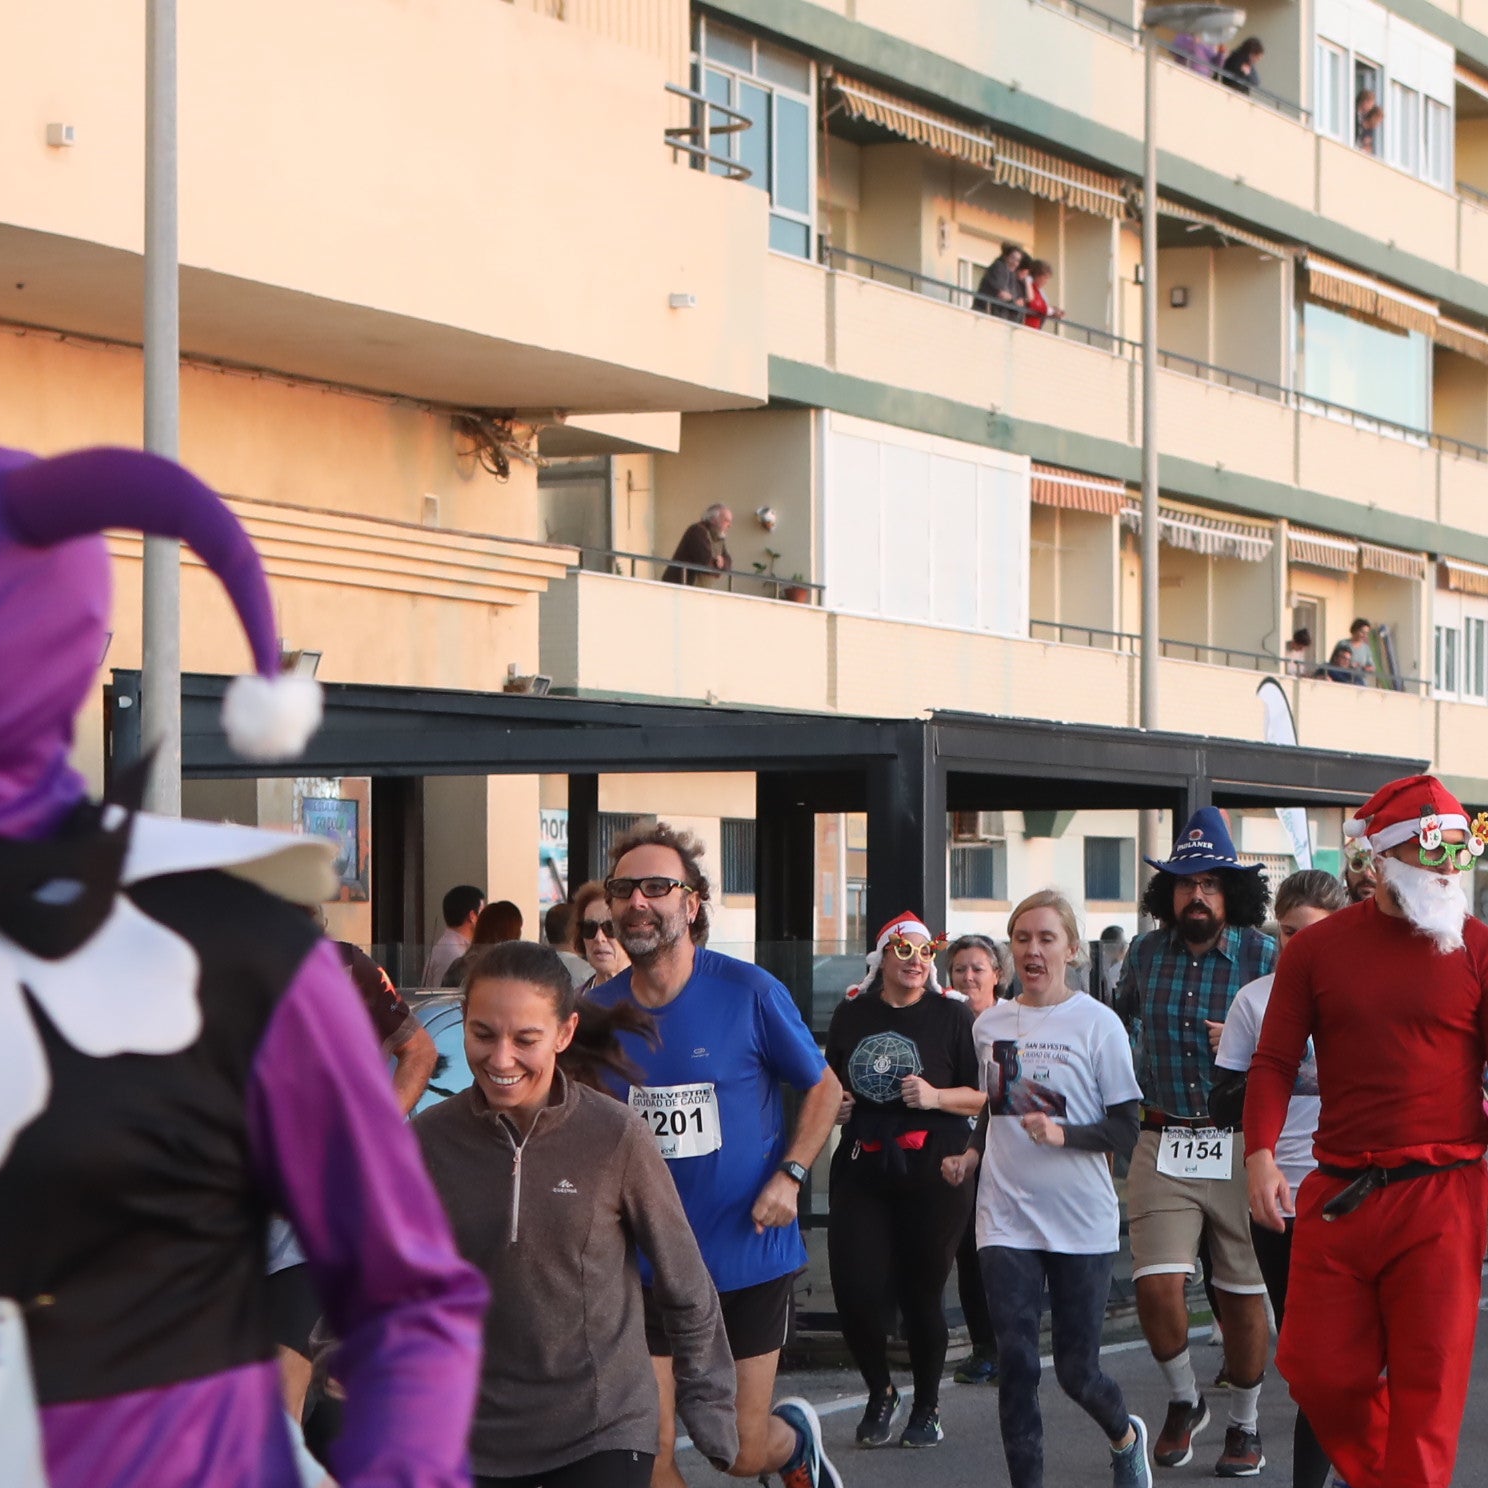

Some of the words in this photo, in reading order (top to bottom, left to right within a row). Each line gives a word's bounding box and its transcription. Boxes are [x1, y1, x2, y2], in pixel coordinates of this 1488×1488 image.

[1177, 842, 1213, 851] PAULANER
[650, 1089, 710, 1100] SILVESTRE
[632, 1099, 662, 1107] CIUDAD
[665, 1099, 678, 1107] DE
[1170, 1141, 1222, 1160] 1154
